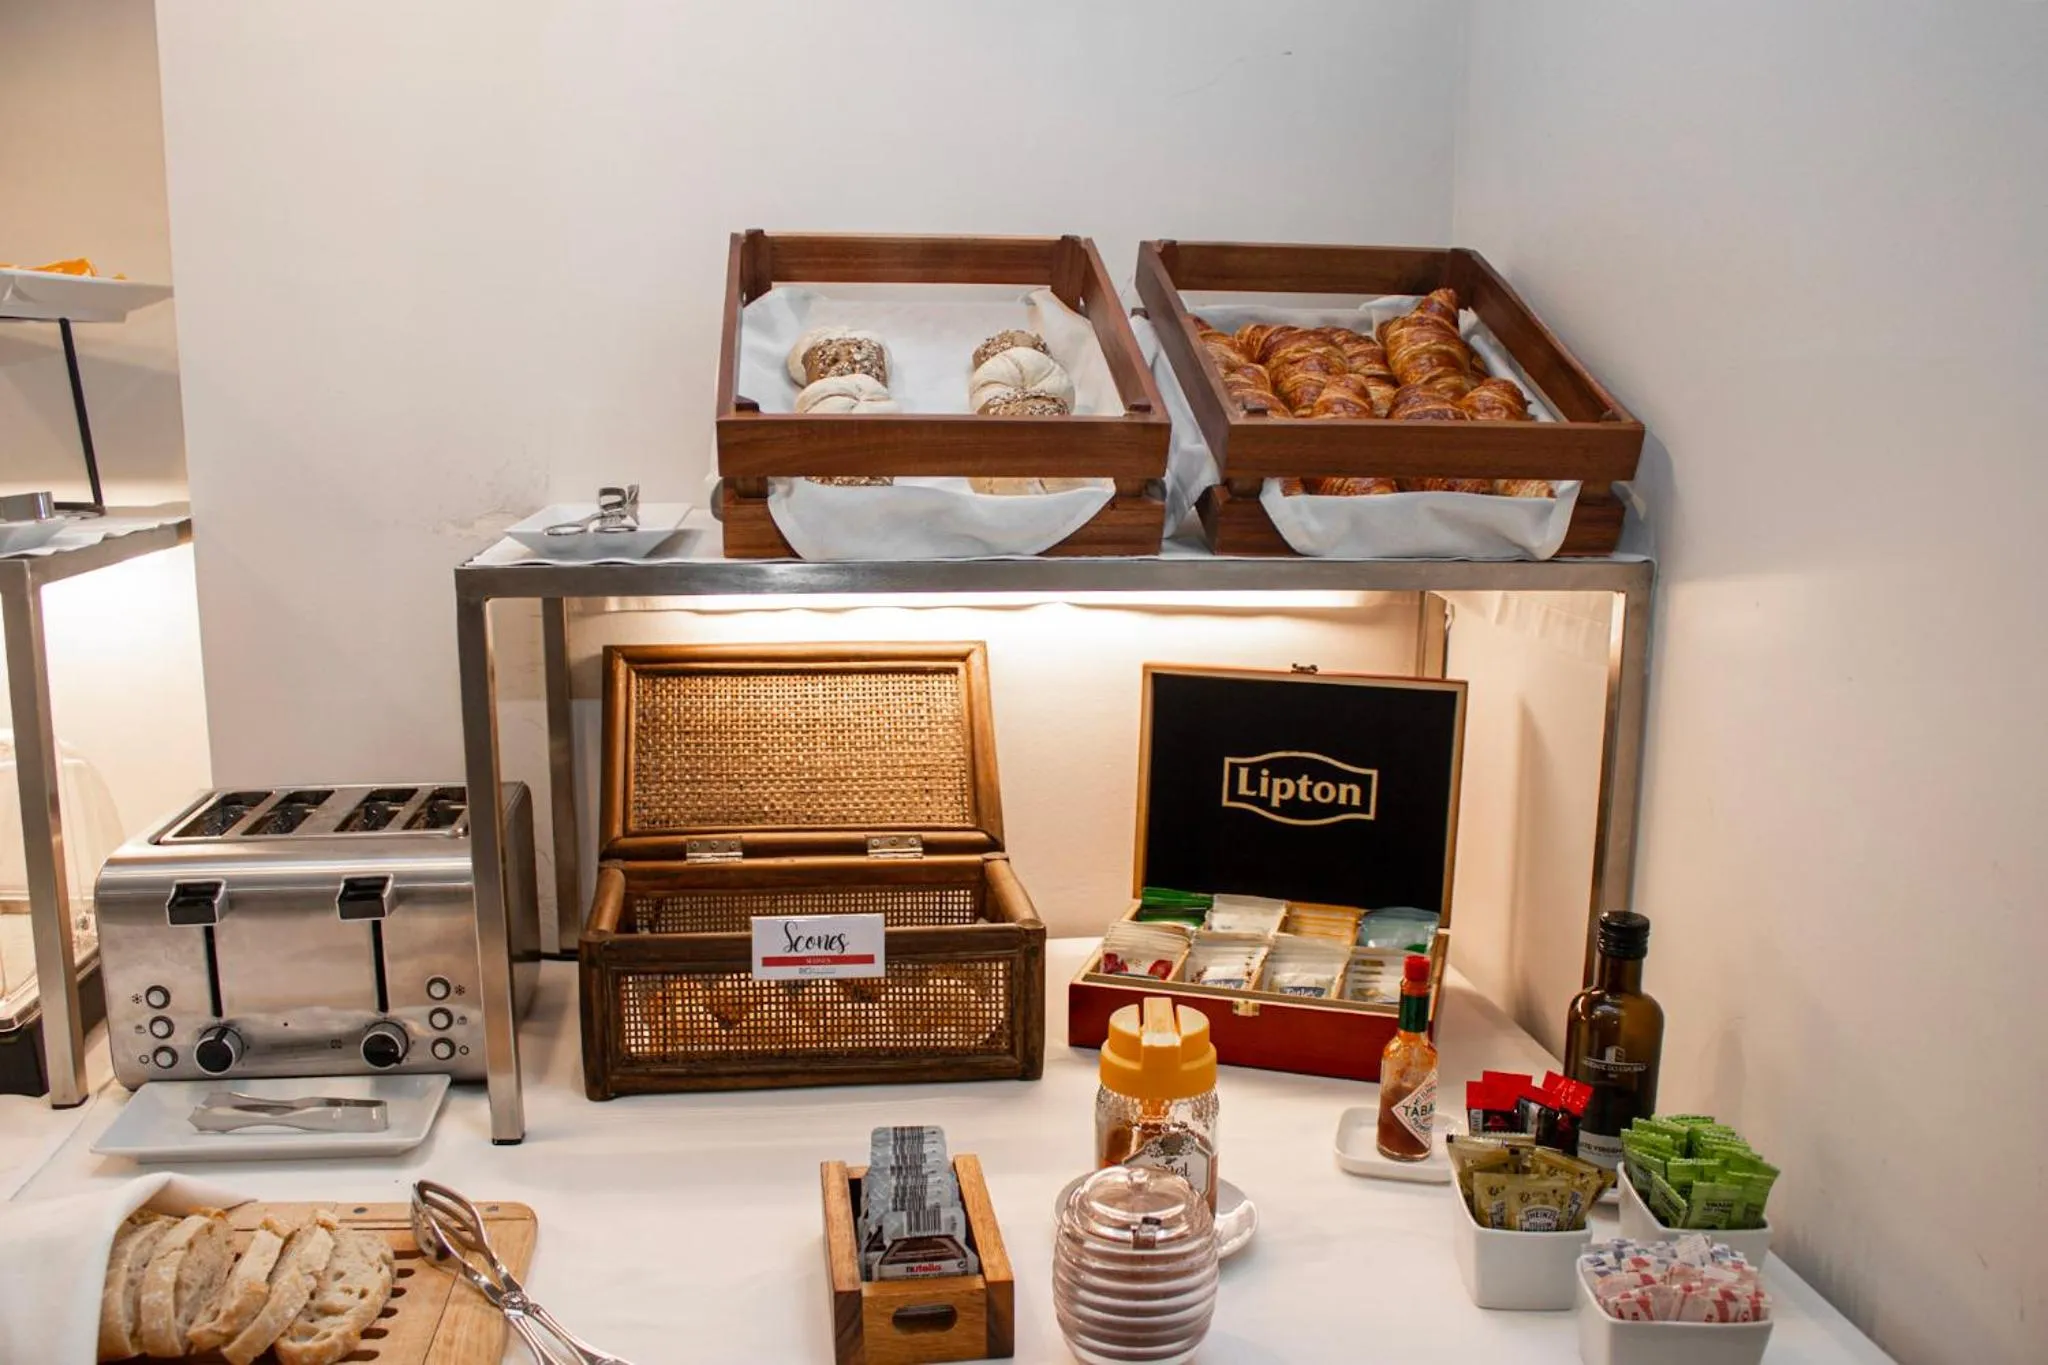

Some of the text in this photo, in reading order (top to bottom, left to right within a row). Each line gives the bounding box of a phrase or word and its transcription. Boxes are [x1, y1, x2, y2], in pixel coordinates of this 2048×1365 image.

[1237, 766, 1361, 808] Lipton
[782, 921, 849, 954] Scones
[906, 1263, 944, 1273] nutella
